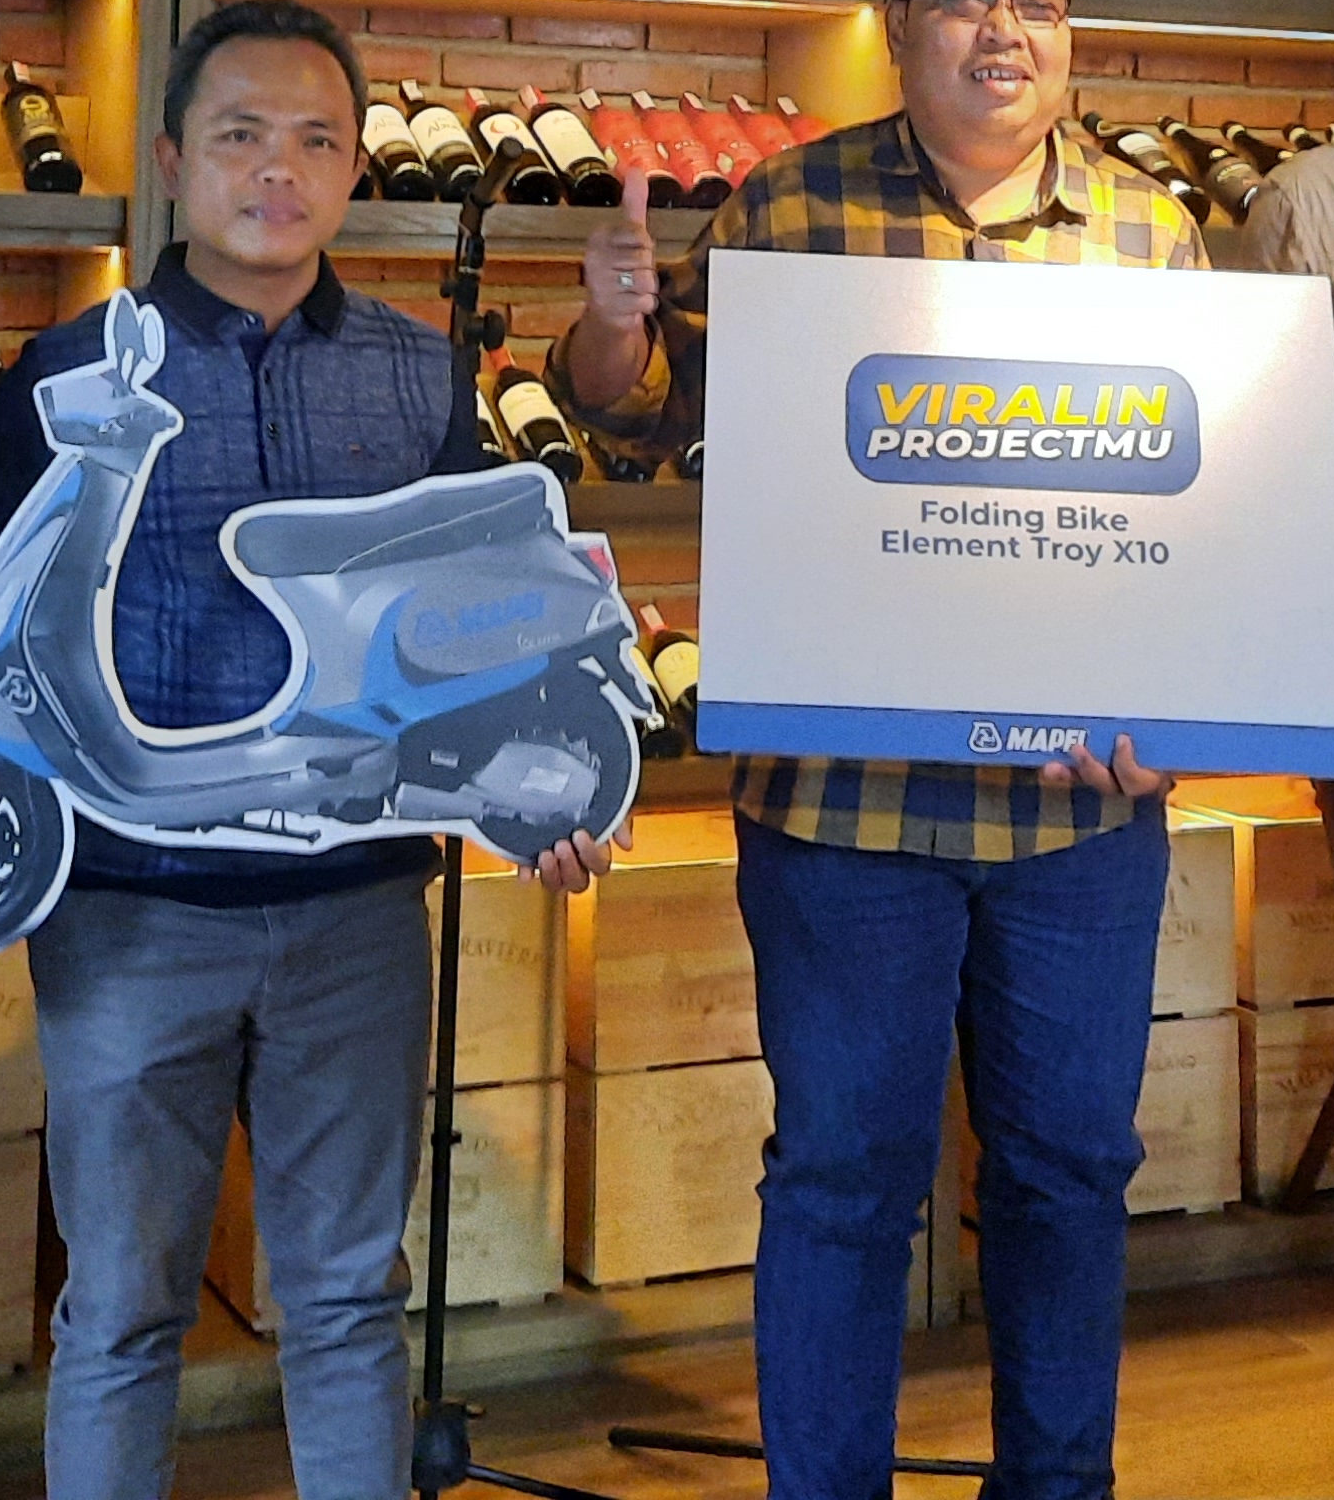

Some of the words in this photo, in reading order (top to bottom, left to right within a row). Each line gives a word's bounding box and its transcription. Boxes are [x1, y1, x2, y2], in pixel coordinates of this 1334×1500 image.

[876, 382, 1170, 426] VIRALIN
[866, 426, 1173, 460] PROJECTMU
[919, 499, 1044, 532] Folding
[1056, 505, 1130, 533] Bike
[880, 529, 1021, 559] Element
[1033, 536, 1103, 568] Troy
[1113, 539, 1171, 566] X10
